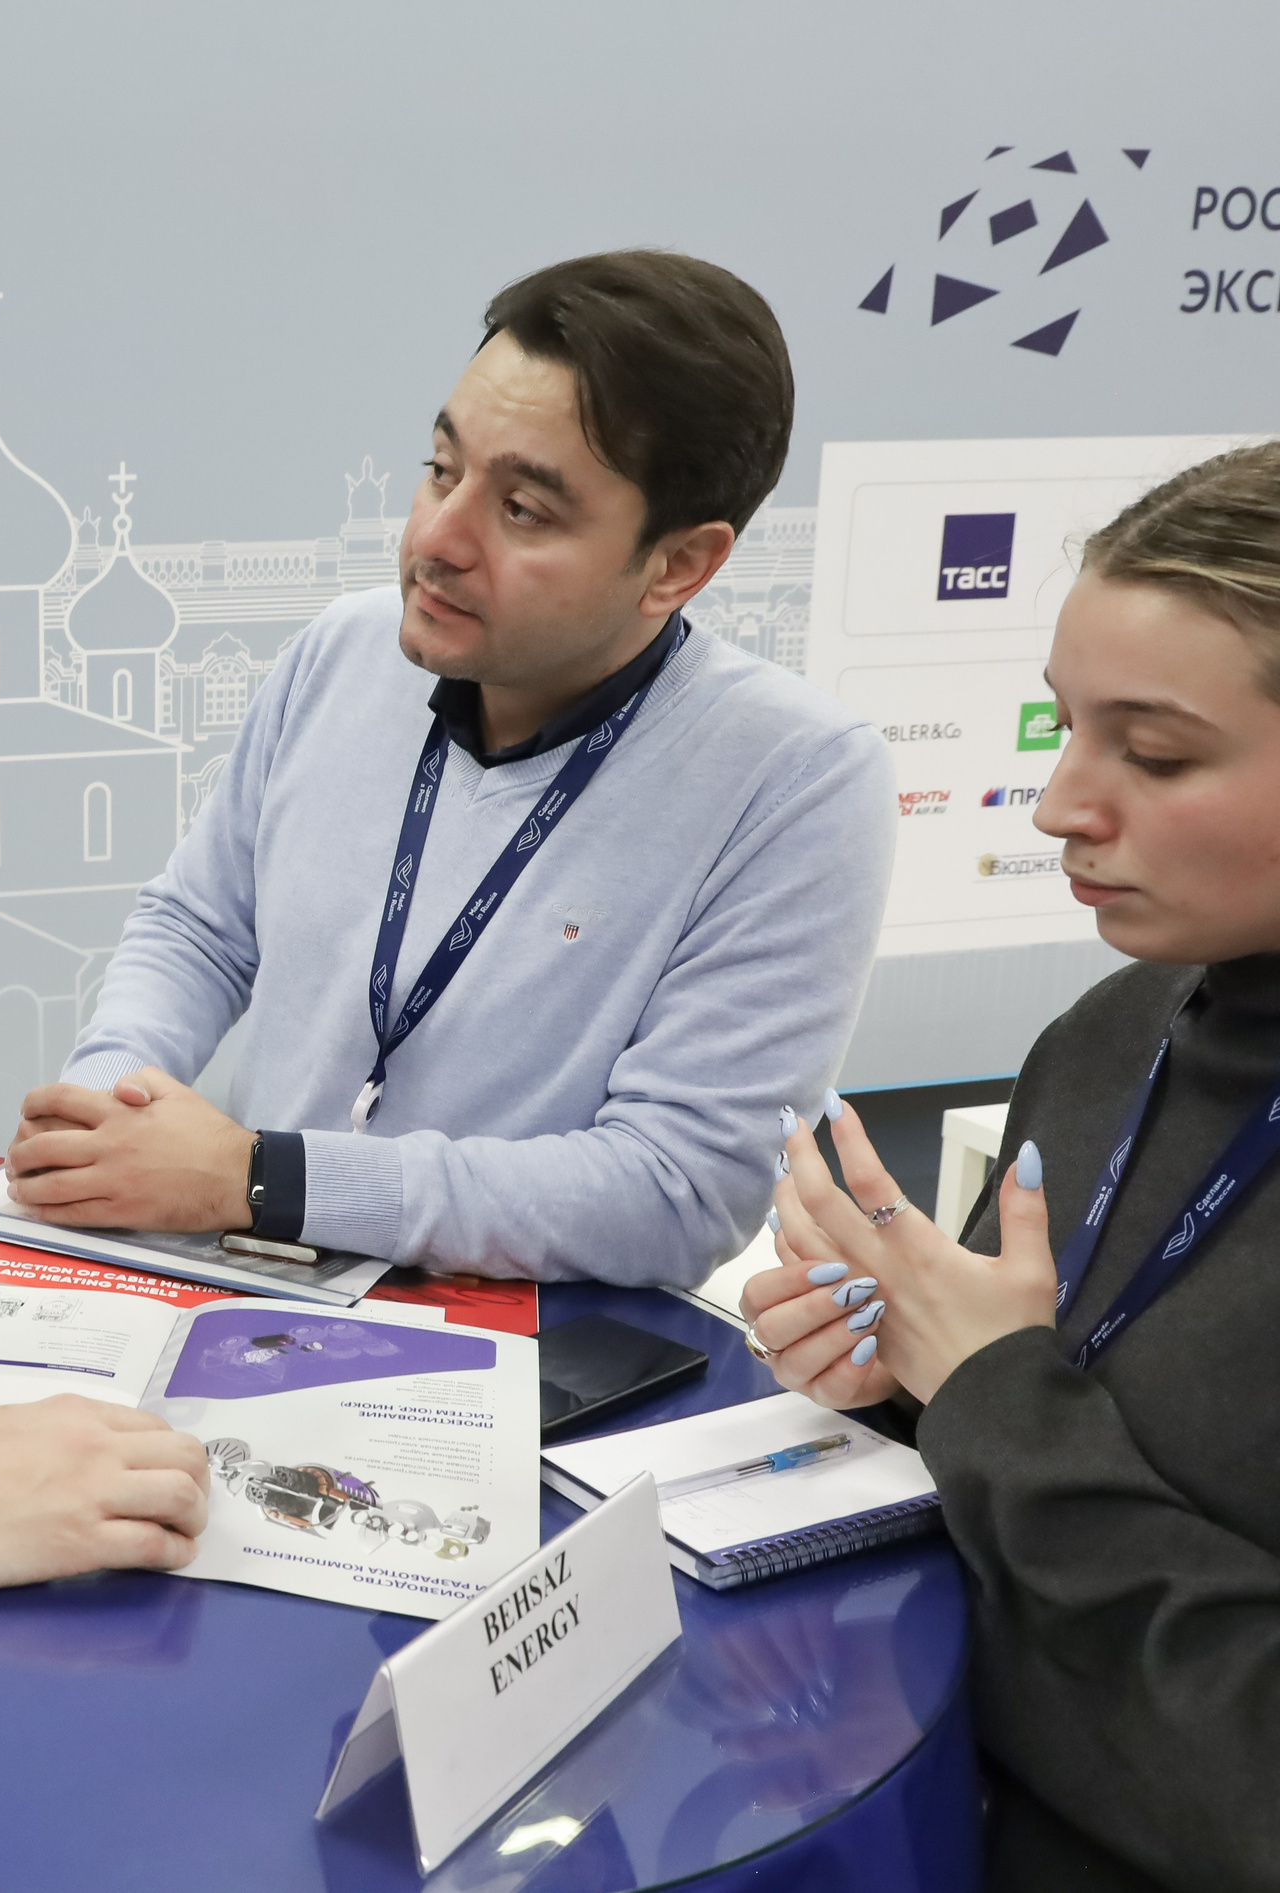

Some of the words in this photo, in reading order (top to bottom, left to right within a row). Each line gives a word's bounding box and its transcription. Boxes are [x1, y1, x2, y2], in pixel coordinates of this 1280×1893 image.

[1179, 268, 1280, 313] ЭКС
[537, 789, 560, 817] Сделано
[547, 792, 567, 816] России
[392, 890, 400, 898] in
[396, 892, 407, 912] Made
[475, 913, 484, 921] in
[480, 892, 498, 914] Russia
[386, 899, 398, 922] Russia
[468, 898, 484, 917] Made
[1195, 1173, 1228, 1212] Сделано
[1208, 1179, 1237, 1211] России
[0, 1267, 37, 1280] AND
[39, 1273, 112, 1289] HEATING
[115, 1283, 179, 1299] PANELS
[76, 1268, 100, 1278] OF
[103, 1272, 158, 1286] CABLE
[160, 1279, 234, 1295] HEATING
[340, 1400, 393, 1411] НИОКР)
[397, 1404, 442, 1415] (ОКР,
[446, 1409, 494, 1420] СИСТЕМ
[358, 1410, 494, 1429] ПРОЕКТИРОВАНИЕ
[242, 1546, 363, 1572] КОМПОНЕНТОВ
[369, 1566, 470, 1590] РАЗРАБОТКА
[482, 1550, 572, 1646] BEHSAZ
[490, 1592, 581, 1696] ENERGY
